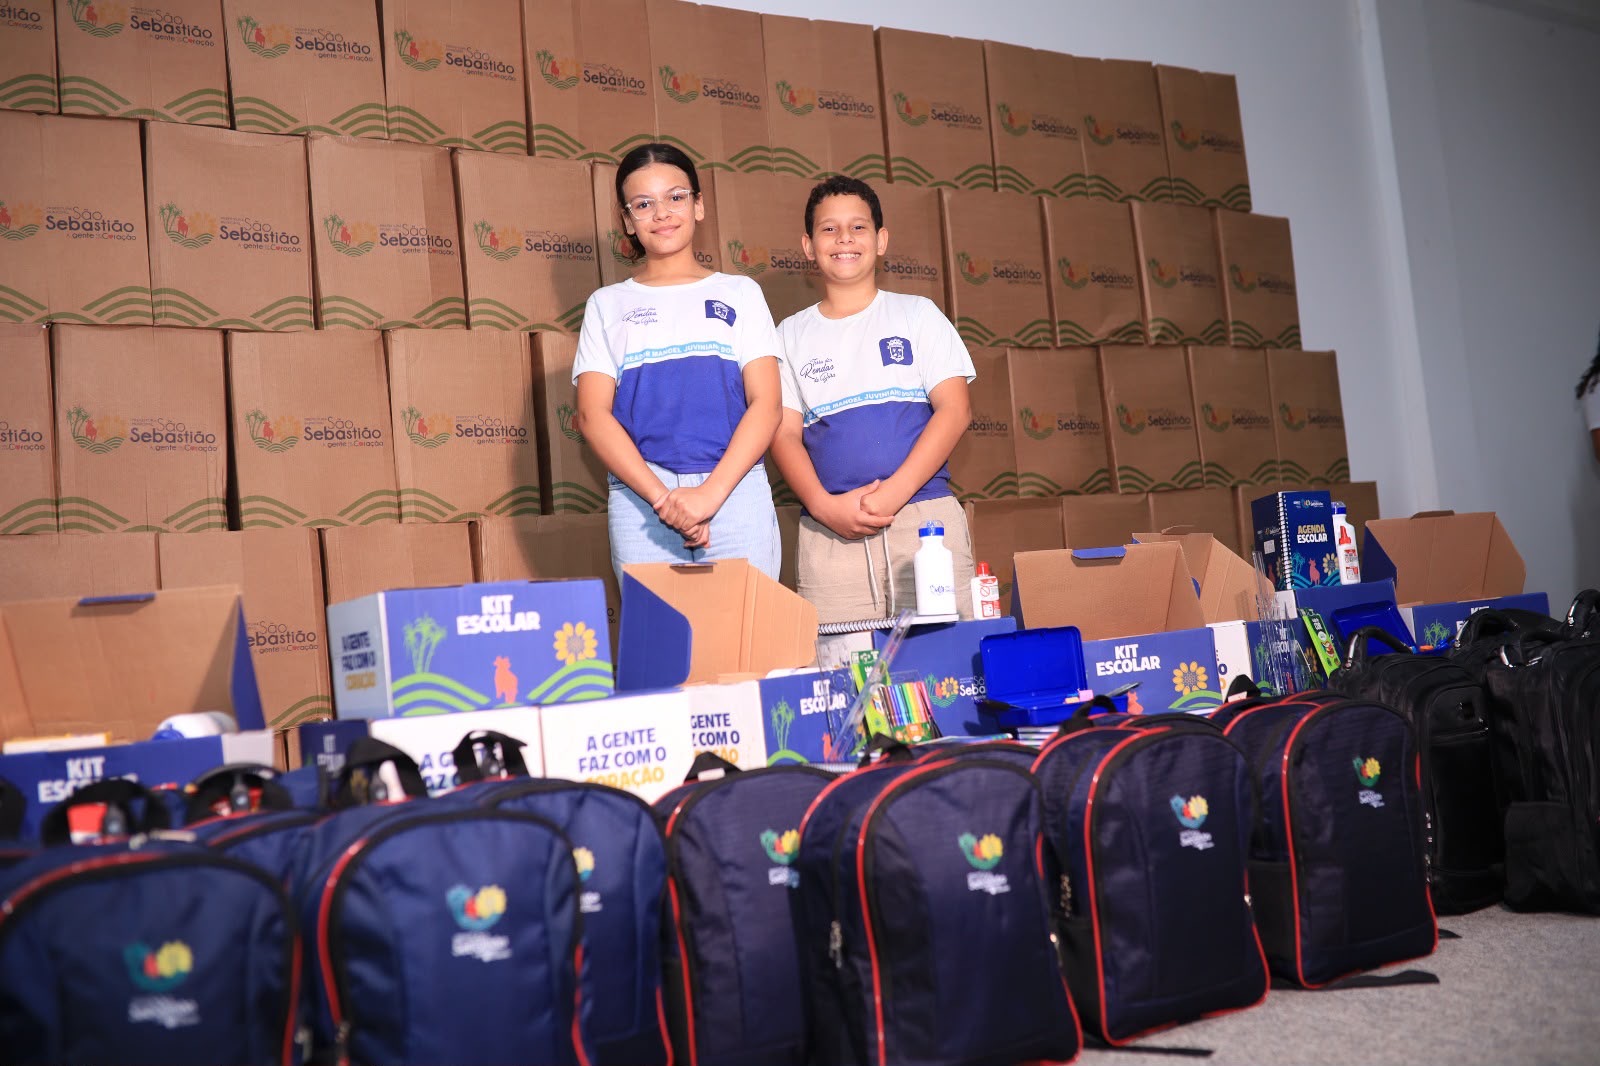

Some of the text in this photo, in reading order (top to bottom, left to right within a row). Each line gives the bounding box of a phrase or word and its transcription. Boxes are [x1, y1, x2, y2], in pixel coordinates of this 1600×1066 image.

[0, 7, 41, 22] stião
[130, 15, 213, 39] Sebastião
[295, 36, 371, 54] Sebastião
[445, 52, 515, 74] Sebastião
[583, 70, 646, 89] Sebastião
[702, 85, 760, 104] Sebastião
[818, 97, 874, 113] Sebastião
[931, 109, 982, 125] Sebastião
[45, 215, 135, 233] Sebastião
[220, 225, 300, 245] Sebastião
[380, 232, 453, 248] Sebastião
[525, 238, 593, 254] Sebastião
[770, 256, 819, 270] Sebastiã
[883, 261, 938, 276] Sebastião
[993, 266, 1042, 280] Sebastião
[625, 349, 651, 362] READR
[651, 347, 682, 358] MANOEL
[683, 342, 720, 354] JUVINIAN
[799, 362, 835, 379] Rendas
[832, 396, 863, 409] MANOEL
[303, 426, 382, 441] Sebastião
[455, 423, 527, 438] Sebastião
[967, 420, 1008, 431] ebastião
[0, 429, 43, 443] stião
[130, 427, 216, 444] Sebastião
[1297, 524, 1326, 534] AGENDA
[1297, 533, 1328, 544] ESCOLAR
[480, 594, 514, 616] KIT
[456, 611, 541, 636] ESCOLAR
[248, 631, 317, 647] ebastião
[1114, 644, 1139, 660] KIT
[1096, 655, 1161, 677] ESCOLAR
[813, 678, 832, 697] KIT
[800, 692, 847, 716] ESCOLAR
[586, 728, 656, 752] A GENTE
[698, 731, 728, 746] COM
[730, 730, 740, 744] O
[66, 756, 106, 780] KIT
[578, 746, 667, 774] FAZ COM O
[423, 774, 447, 790] AZ
[585, 767, 665, 790] ORAÇÃO
